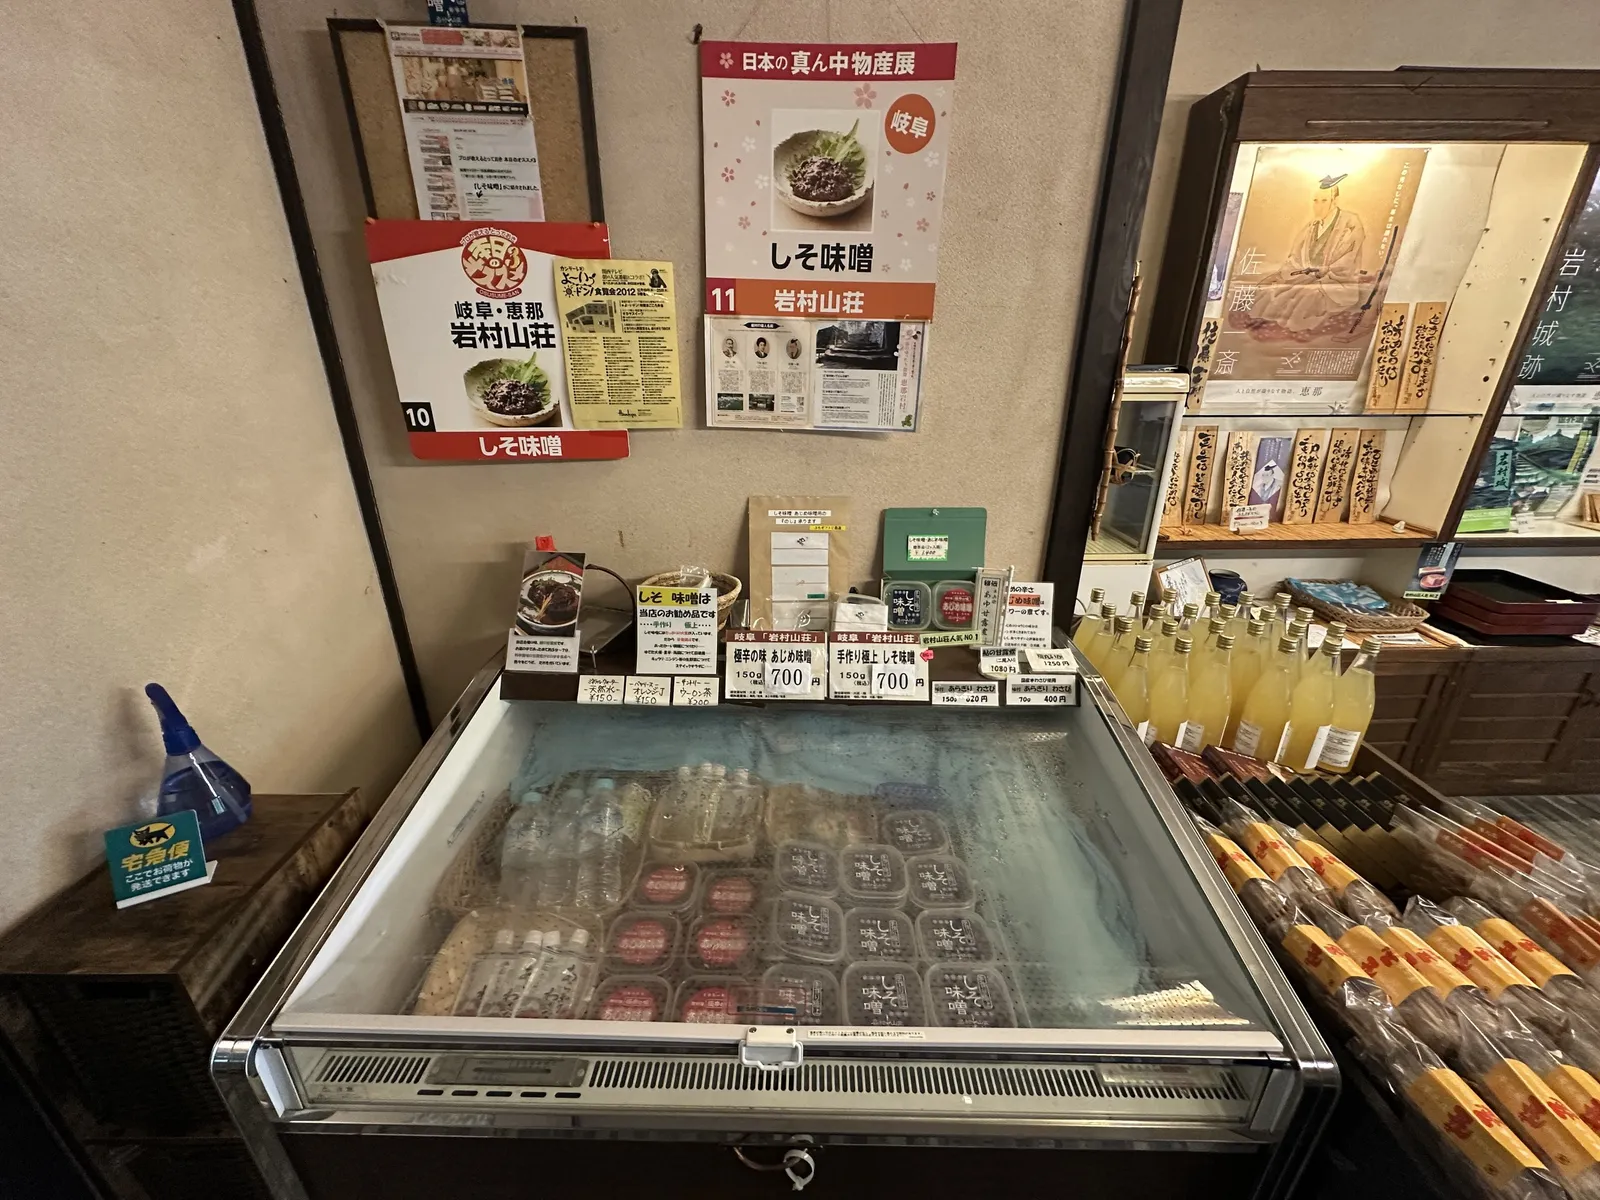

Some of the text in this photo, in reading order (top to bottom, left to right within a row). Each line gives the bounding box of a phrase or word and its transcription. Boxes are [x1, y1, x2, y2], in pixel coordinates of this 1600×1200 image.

[742, 50, 915, 76] 日本の真ん中物産展
[890, 109, 929, 139] 岐阜
[771, 242, 874, 273] しそ味噌
[454, 301, 545, 321] 岐阜・恵那
[711, 287, 735, 312] 11
[774, 289, 865, 314] 岩村山荘
[1213, 246, 1266, 376] 佐藤一斎
[1517, 248, 1586, 380] 岩村城跡
[451, 321, 556, 350] 岩村山荘
[405, 407, 430, 427] 10
[478, 435, 563, 457] しそ味噌
[639, 608, 717, 620] 当店のお勧め品です
[734, 632, 756, 642] 岐阜
[837, 633, 859, 643] 岐阜
[733, 647, 812, 664] 極辛の味 あじめ味噌
[836, 648, 915, 665] 手作り極上 しそ味噌
[771, 668, 803, 686] 700
[811, 677, 821, 686] 円
[839, 671, 866, 680] 150g
[876, 672, 909, 690] 700
[915, 678, 925, 687] 円
[980, 695, 988, 703] 円
[1043, 695, 1058, 703] 400
[1059, 695, 1067, 703] 円
[121, 840, 190, 872] 宅急便
[125, 859, 194, 883] ここでお荷物が
[130, 868, 191, 892] 発送できます
[877, 920, 891, 946] しそ
[950, 920, 966, 944] しそ
[862, 985, 883, 1016] 味噌
[881, 975, 898, 1008] しそ
[944, 984, 968, 1016] 味噌
[963, 975, 982, 1008] しそ
